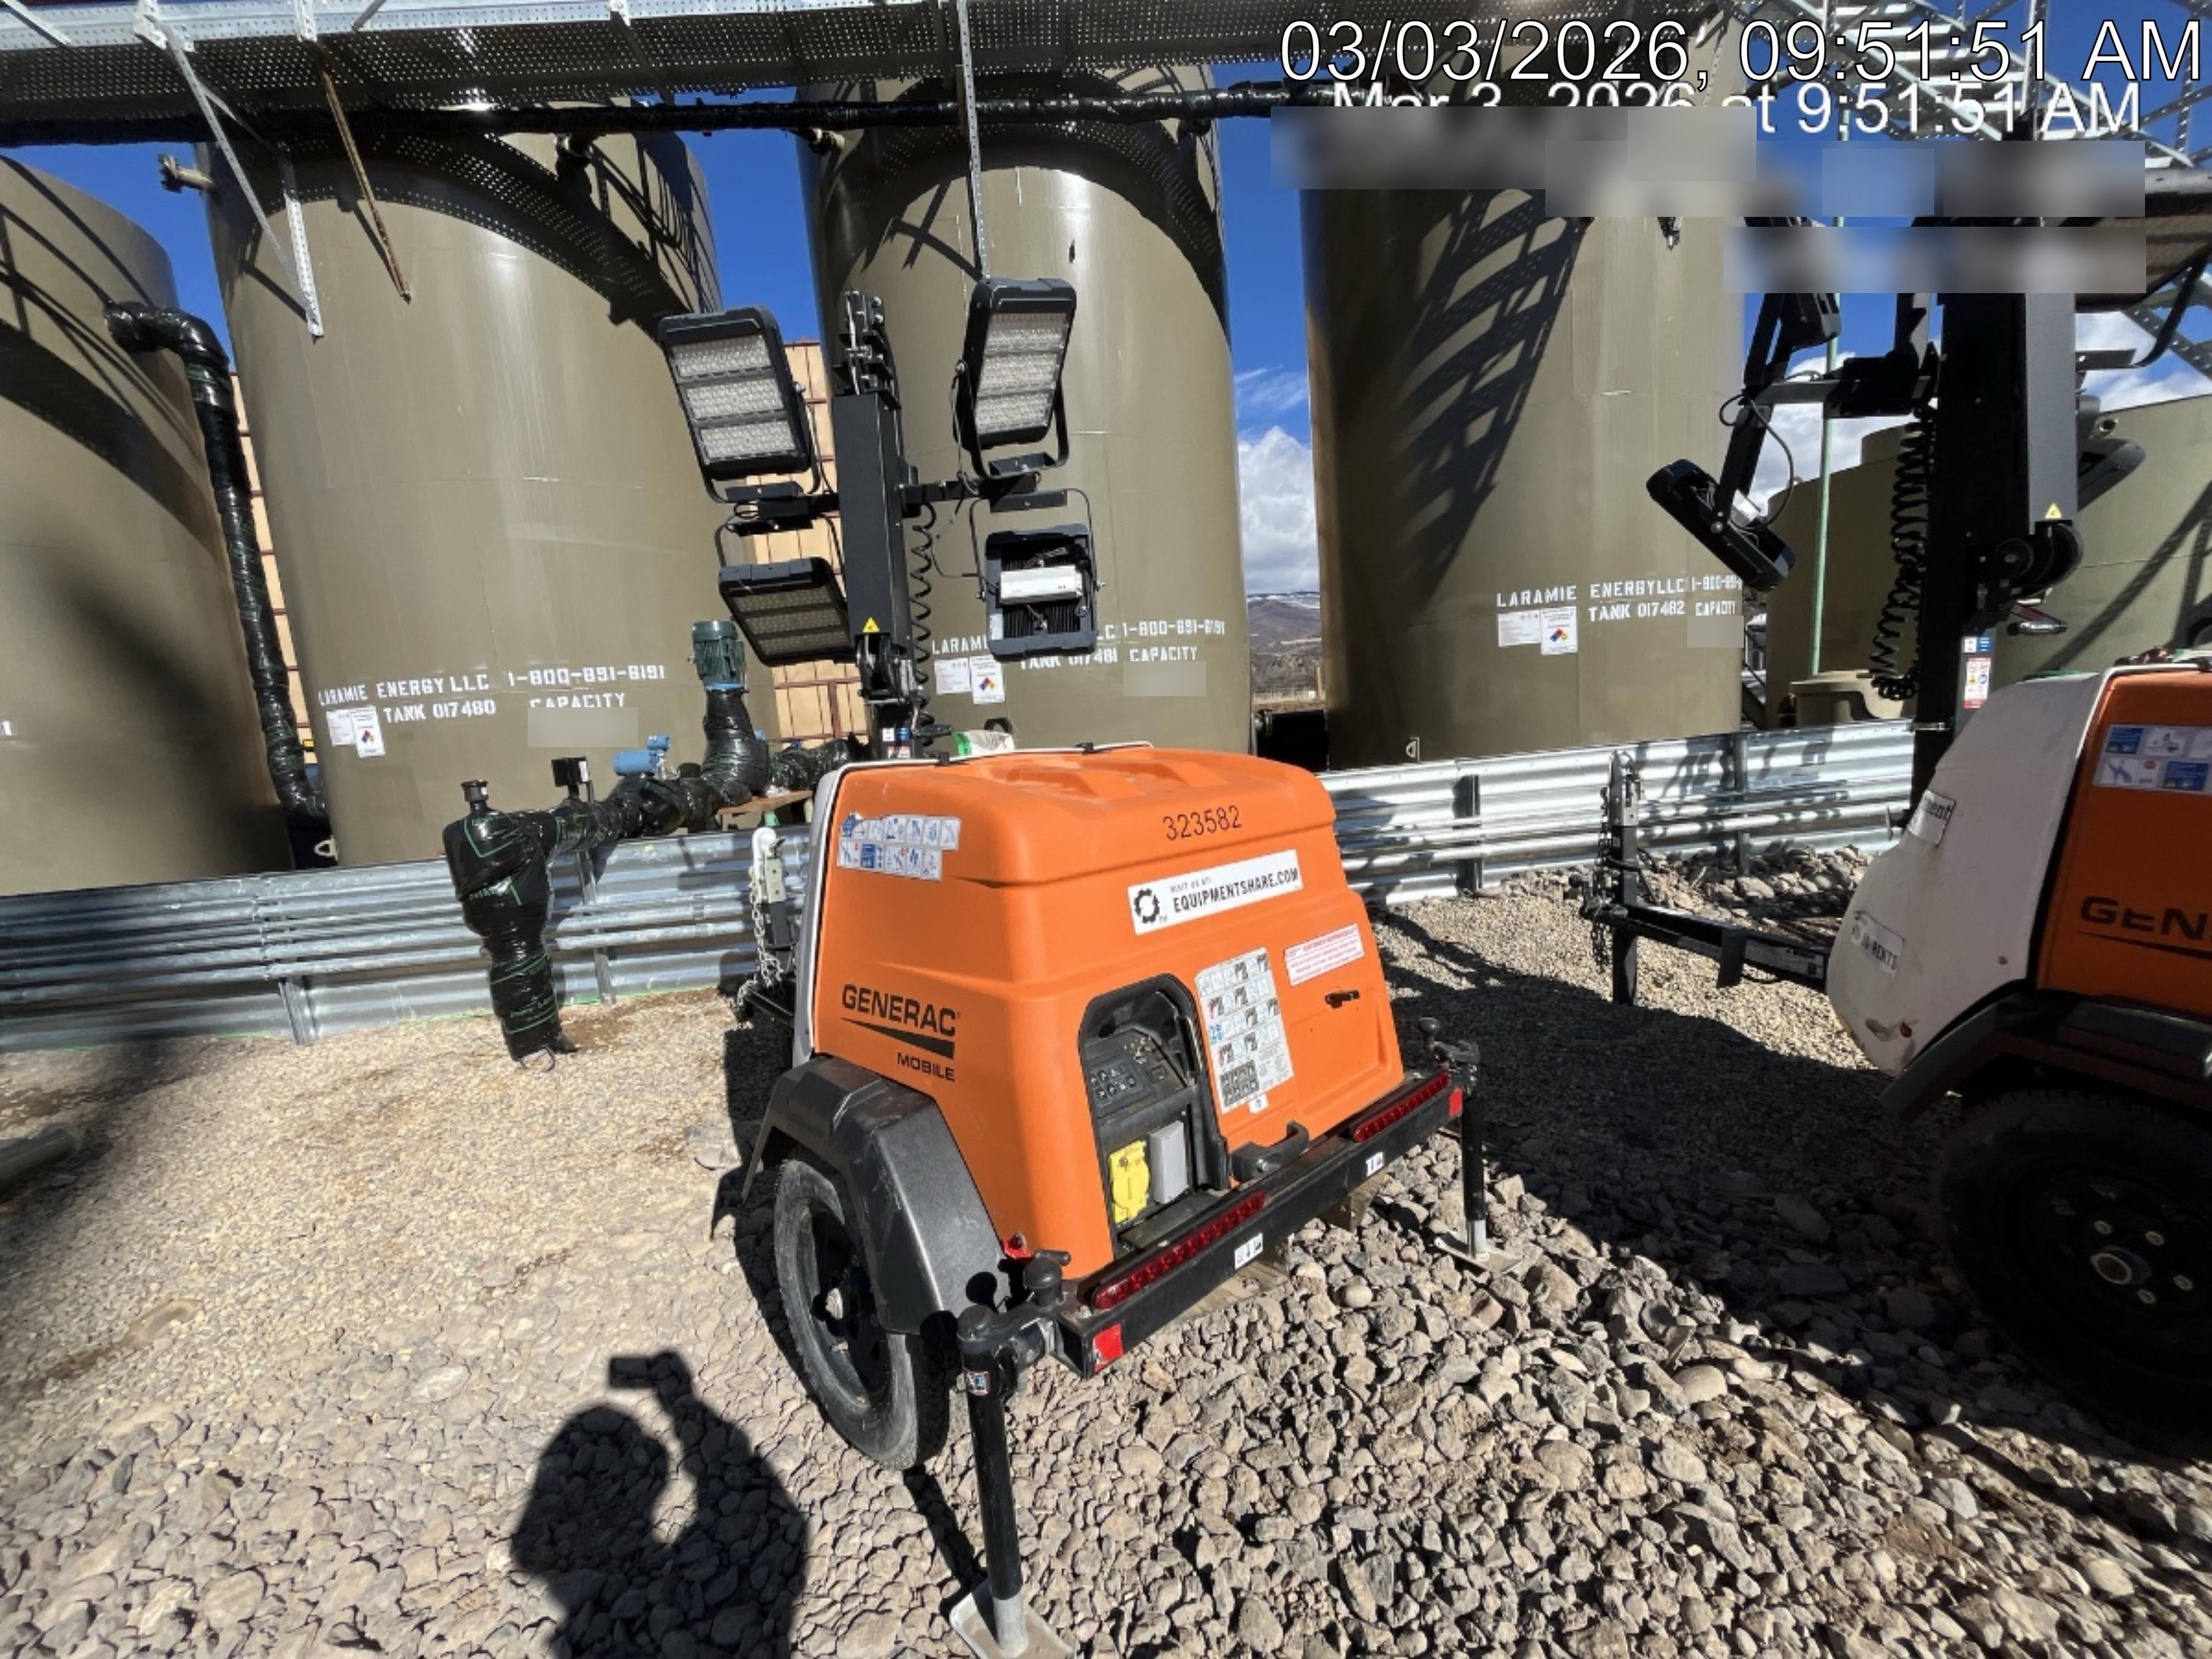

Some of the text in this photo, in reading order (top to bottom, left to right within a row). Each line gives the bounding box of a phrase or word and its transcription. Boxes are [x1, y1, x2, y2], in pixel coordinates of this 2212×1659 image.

[1496, 585, 1577, 607] LARAMIE
[1589, 600, 1631, 622] TANK
[932, 634, 988, 655] LARAMI
[1129, 646, 1197, 662] CAPACITY
[318, 684, 367, 706] LARAMIE
[376, 677, 444, 699] ENERGY
[449, 673, 490, 692] LLC
[383, 704, 426, 723] TANK
[1163, 805, 1242, 841] 323582
[1173, 867, 1298, 913] EQUIPMENTSHARE.COM
[842, 984, 956, 1037] GENERAC
[897, 1052, 955, 1083] MOBILE
